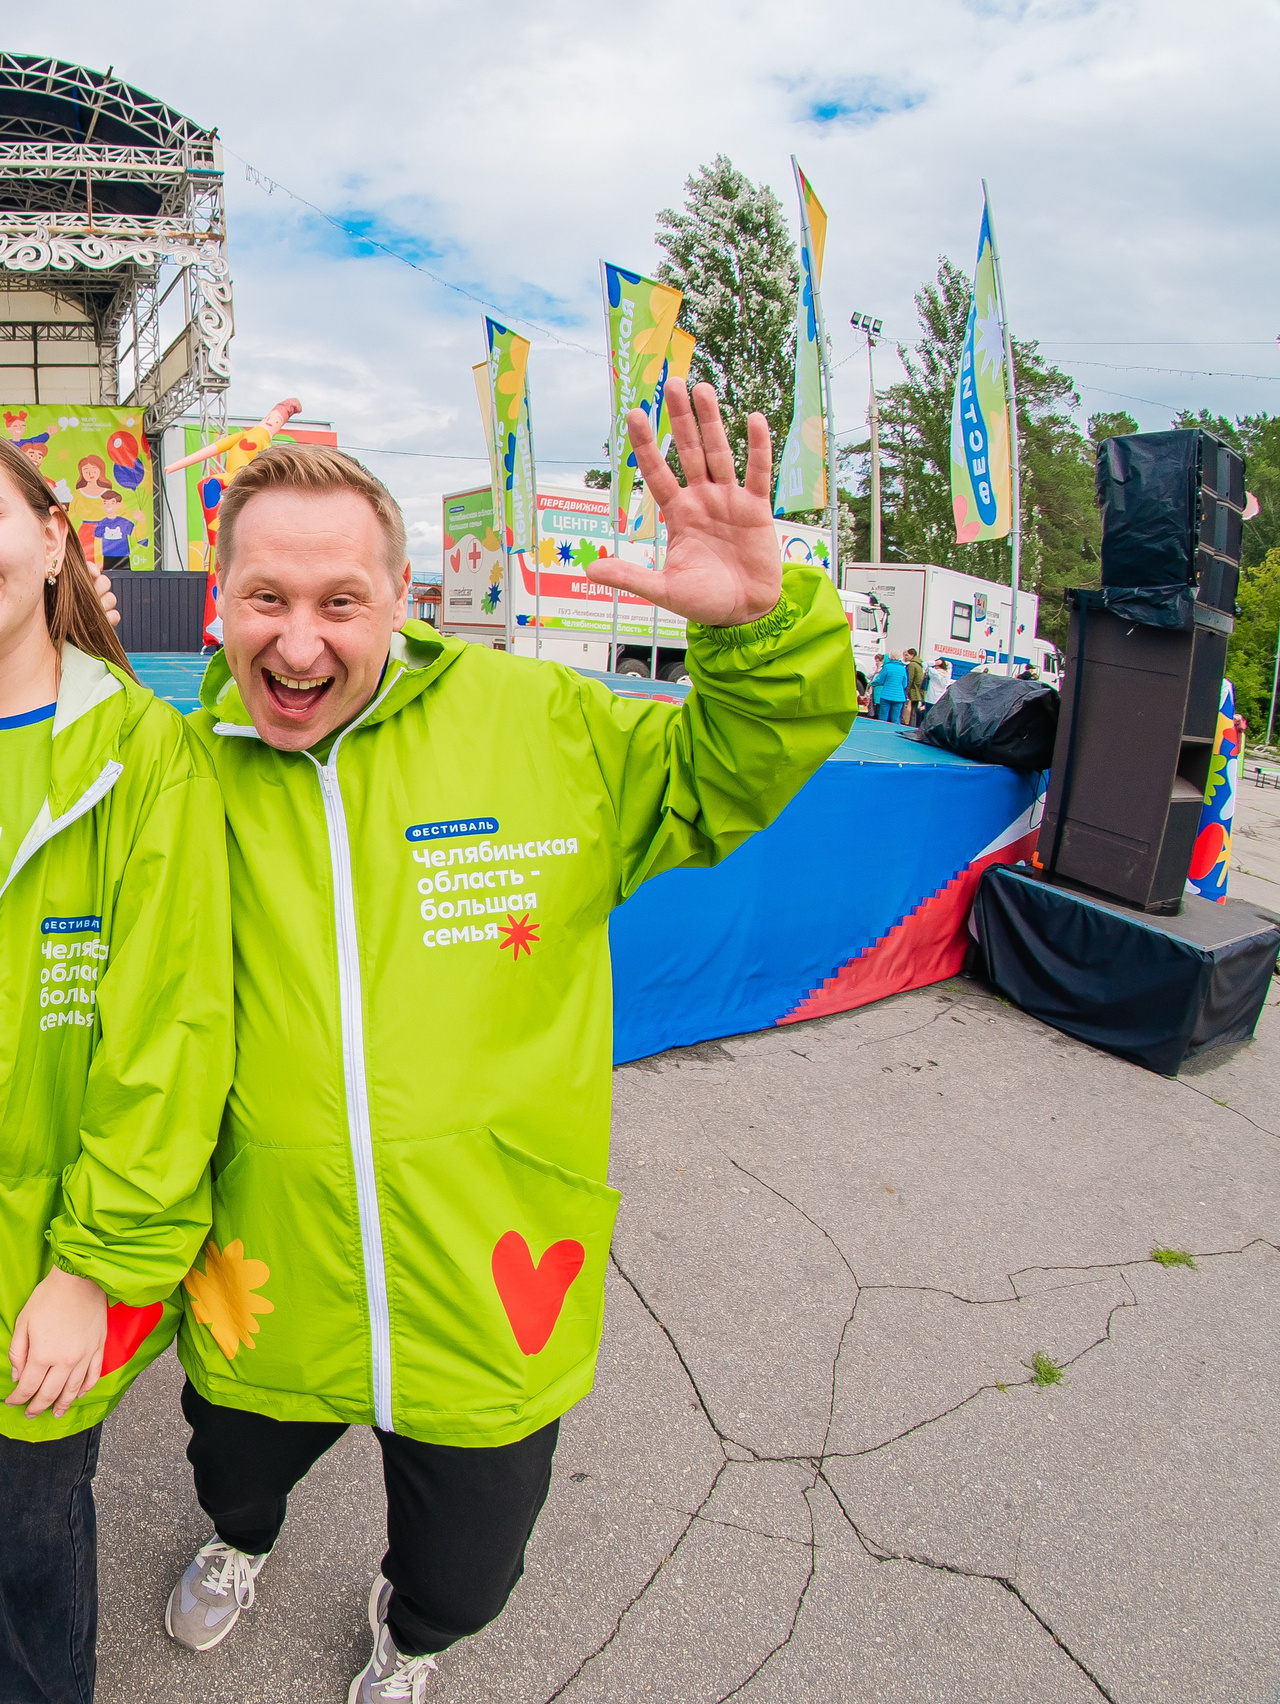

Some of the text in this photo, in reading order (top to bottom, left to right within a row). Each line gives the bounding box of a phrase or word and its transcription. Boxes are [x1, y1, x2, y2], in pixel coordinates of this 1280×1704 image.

[540, 497, 610, 514] ПЕРЕДВИЖНОЙ
[553, 515, 598, 532] ЦЕНТР
[132, 554, 147, 565] 0+
[561, 619, 611, 630] Челябинская
[617, 623, 642, 633] бласть
[648, 626, 679, 637] бльшая
[412, 821, 494, 838] ФЕСТИВАЛЬ
[412, 837, 579, 868] Челябинская
[417, 868, 524, 895] область
[420, 892, 537, 921] большая
[422, 922, 499, 948] семья
[40, 963, 98, 984] облас
[40, 987, 95, 1008] боль
